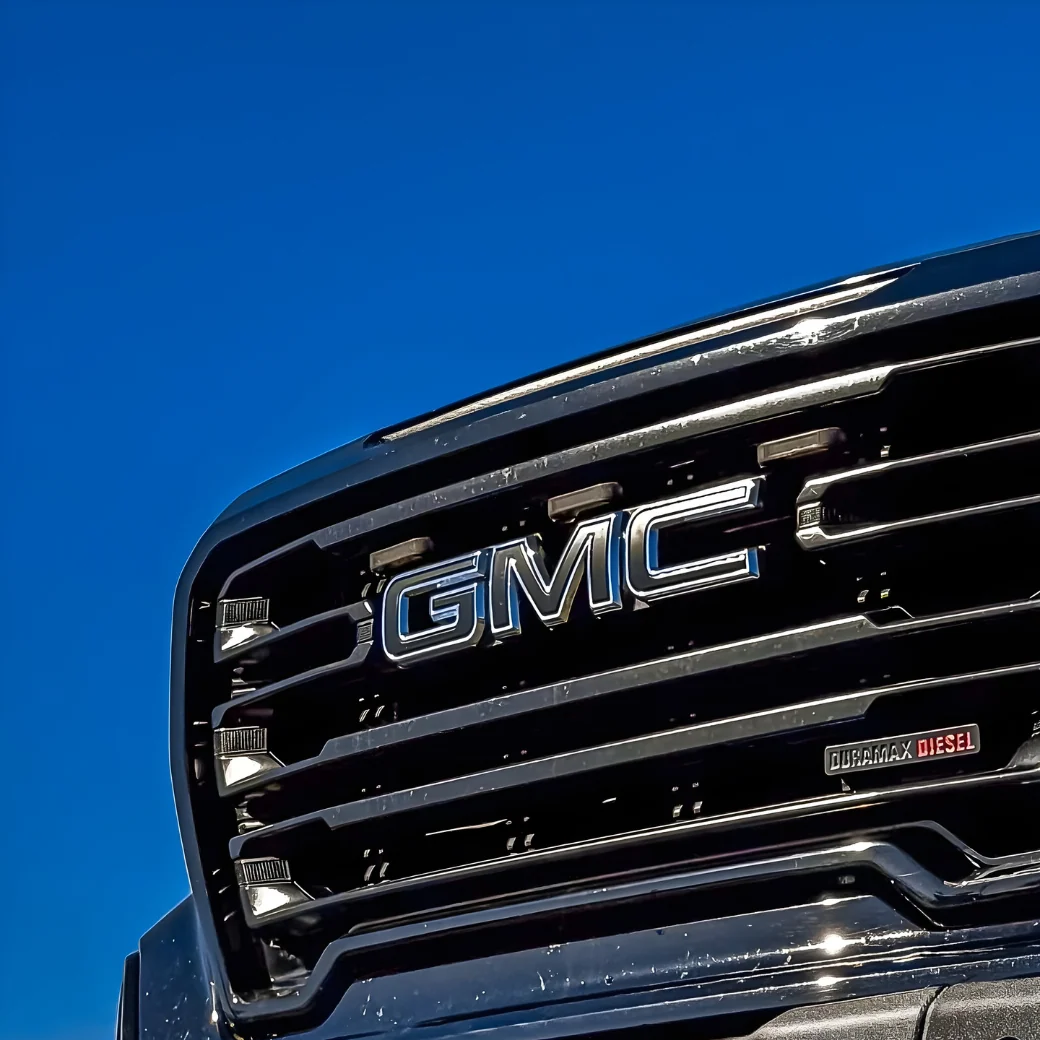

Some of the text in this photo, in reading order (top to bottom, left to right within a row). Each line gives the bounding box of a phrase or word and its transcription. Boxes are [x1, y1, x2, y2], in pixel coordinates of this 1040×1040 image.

[382, 475, 766, 663] GMC
[830, 731, 975, 771] DURAMAX DIESEL
